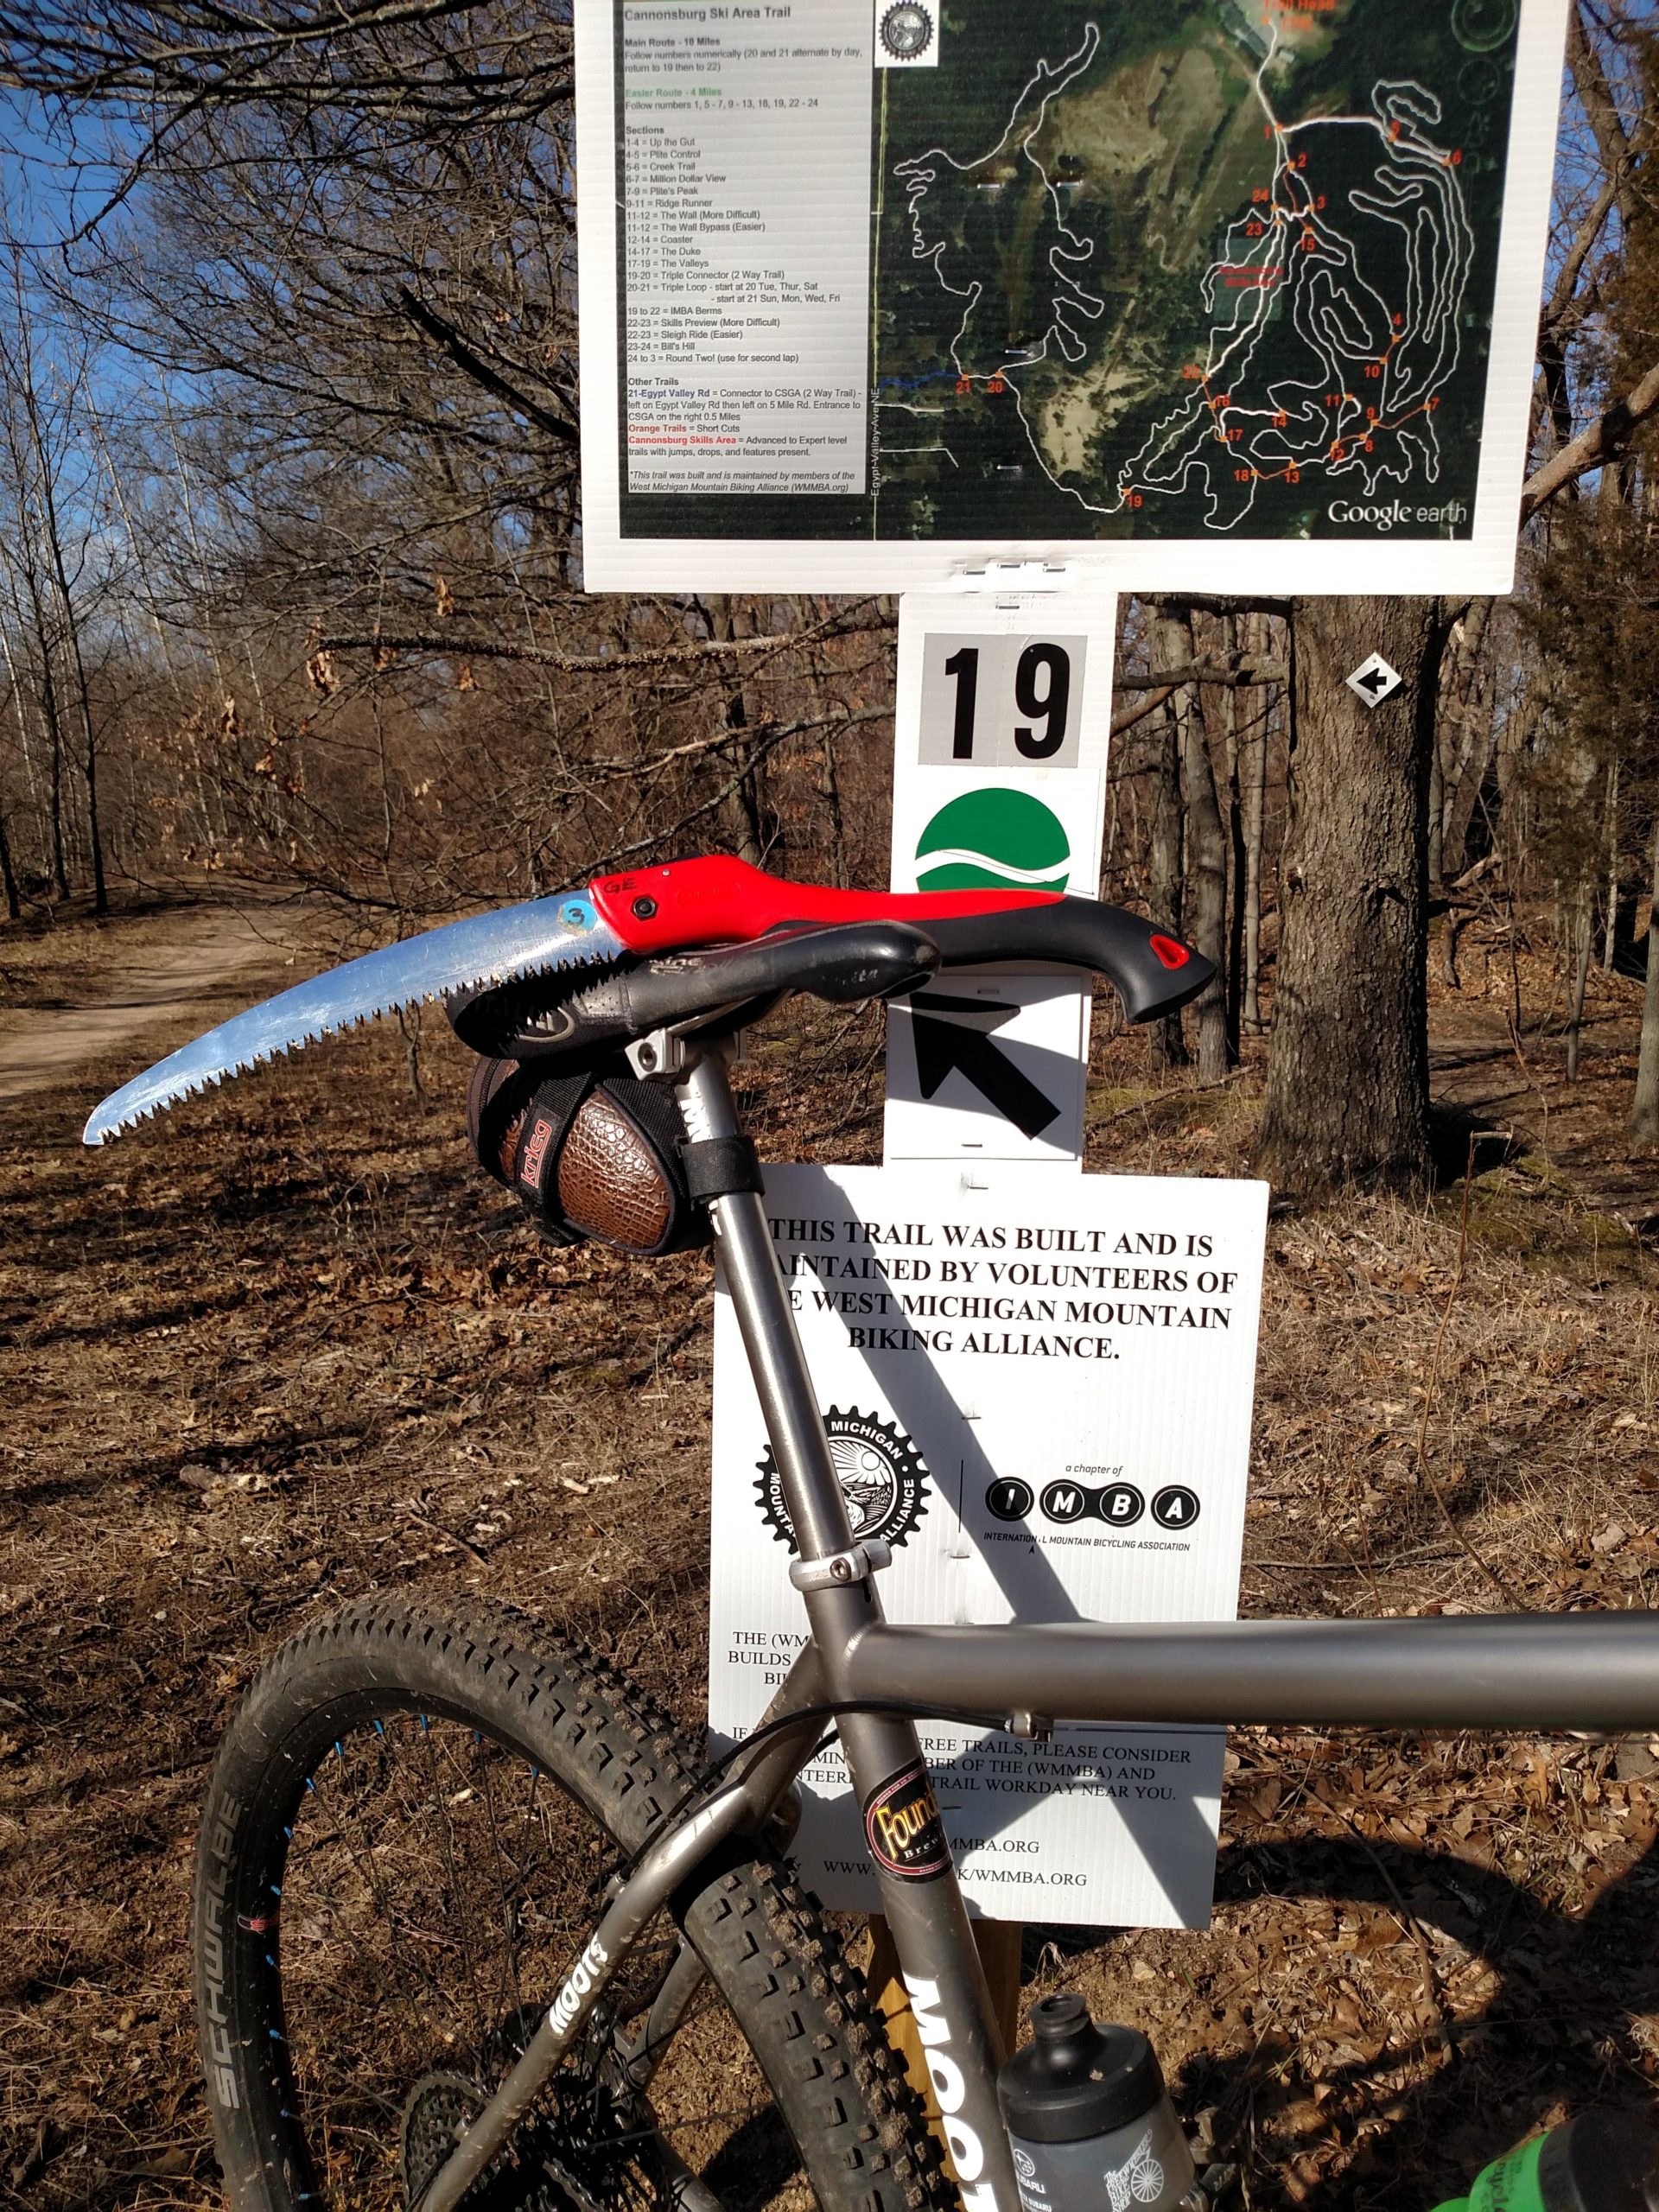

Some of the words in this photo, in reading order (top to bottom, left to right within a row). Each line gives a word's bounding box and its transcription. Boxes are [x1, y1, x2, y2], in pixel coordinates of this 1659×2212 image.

[625, 10, 706, 22] Cannonsburg
[709, 9, 728, 18] Ski
[732, 8, 760, 18] Area
[764, 7, 791, 18] Trail
[626, 126, 664, 135] Sections
[1298, 154, 1306, 168] 2
[626, 175, 640, 183] 6-7
[650, 174, 677, 183] Million
[678, 174, 703, 183] Dollar
[706, 174, 726, 183] View
[1253, 188, 1269, 202] 24
[1318, 197, 1326, 210] 3
[1246, 223, 1262, 236] 23
[1300, 238, 1315, 251] 15
[1393, 314, 1402, 326] 4
[1363, 365, 1379, 378] 10
[628, 378, 652, 386] Other
[654, 378, 678, 386] Trails
[956, 381, 971, 394] 21
[987, 381, 1003, 394] 20
[870, 388, 880, 404] NE
[1216, 395, 1230, 407] 16
[1325, 395, 1340, 407] 11
[655, 401, 678, 411] Egypt
[681, 401, 706, 410] Valley
[797, 400, 811, 409] Rd.
[814, 400, 849, 409] Entrance
[852, 400, 861, 409] to
[1431, 397, 1440, 411] 7
[684, 412, 702, 423] right
[719, 412, 741, 421] Miles
[1366, 407, 1375, 419] 9
[1271, 416, 1287, 428] 14
[629, 424, 660, 435] Orange
[1228, 429, 1243, 441] 17
[1365, 440, 1373, 452] 8
[629, 448, 648, 456] trails
[650, 448, 666, 456] with
[668, 448, 696, 458] jumps,
[697, 448, 723, 458] drops,
[725, 448, 741, 456] and
[742, 448, 776, 456] features
[778, 448, 810, 458] present.
[1329, 448, 1345, 461] 12
[652, 471, 668, 480] trail
[687, 471, 703, 480] built
[706, 471, 721, 480] and
[724, 471, 731, 480] is
[733, 471, 778, 480] maintained
[779, 471, 790, 481] by
[791, 471, 827, 480] members
[829, 471, 838, 480] of
[841, 471, 855, 480] the
[870, 467, 880, 496] Egypt
[1234, 470, 1249, 482] 18
[1284, 472, 1300, 484] 13
[630, 483, 650, 492] West
[652, 483, 689, 493] Michigan
[691, 483, 728, 492] Mountain
[730, 483, 755, 493] Biking
[757, 483, 788, 492] Alliance
[791, 483, 849, 493] (WMMBA.org)
[1127, 495, 1142, 508] 19
[1328, 499, 1411, 531] Google
[1416, 503, 1467, 524] earth
[944, 642, 1071, 760] 19
[568, 907, 585, 926] 3
[520, 1118, 553, 1190] krieg
[768, 1218, 835, 1242] THIS
[843, 1222, 933, 1246] TRAIL
[943, 1224, 1006, 1249] WAS
[1014, 1228, 1106, 1252] BUILT
[1113, 1232, 1177, 1255] AND
[1185, 1235, 1213, 1257] IS
[778, 1254, 931, 1281] AINTAINED
[940, 1261, 979, 1283] BY
[987, 1262, 1188, 1292] VOLUNTEERS
[1197, 1271, 1238, 1294] OF
[811, 1290, 893, 1314] WEST
[901, 1294, 1058, 1322] MICHIGAN
[1065, 1301, 1232, 1329] MOUNTAIN
[847, 1327, 954, 1351] BIKING
[961, 1332, 1120, 1359] ALLIANCE.
[830, 1421, 904, 1459] MICHIGAN
[1074, 1464, 1110, 1477] chapter
[1112, 1465, 1122, 1477] of
[769, 1472, 797, 1537] MOUNTA
[879, 1478, 915, 1542] ALLIANCE
[1049, 1536, 1091, 1547] MOUNTAIN
[1093, 1538, 1136, 1548] BICYCLING
[1138, 1540, 1190, 1552] ASSOCIATION
[733, 1631, 767, 1645] THE
[728, 1650, 791, 1666] BUILDS
[733, 1727, 747, 1739] IF
[962, 1739, 1028, 1758] TRAILS,
[1033, 1744, 1097, 1759] PLEASE
[1103, 1746, 1192, 1764] CONSIDER
[962, 1758, 985, 1771] OF
[989, 1759, 1023, 1774] THE
[1027, 1762, 1112, 1780] (WMMBA)
[1116, 1767, 1155, 1781] AND
[930, 1777, 981, 1790] TRAIL
[986, 1779, 1077, 1796] WORKDAY
[1081, 1784, 1128, 1798] NEAR
[1135, 1788, 1176, 1800] YOU.
[202, 1793, 245, 2108] SCHWALBE
